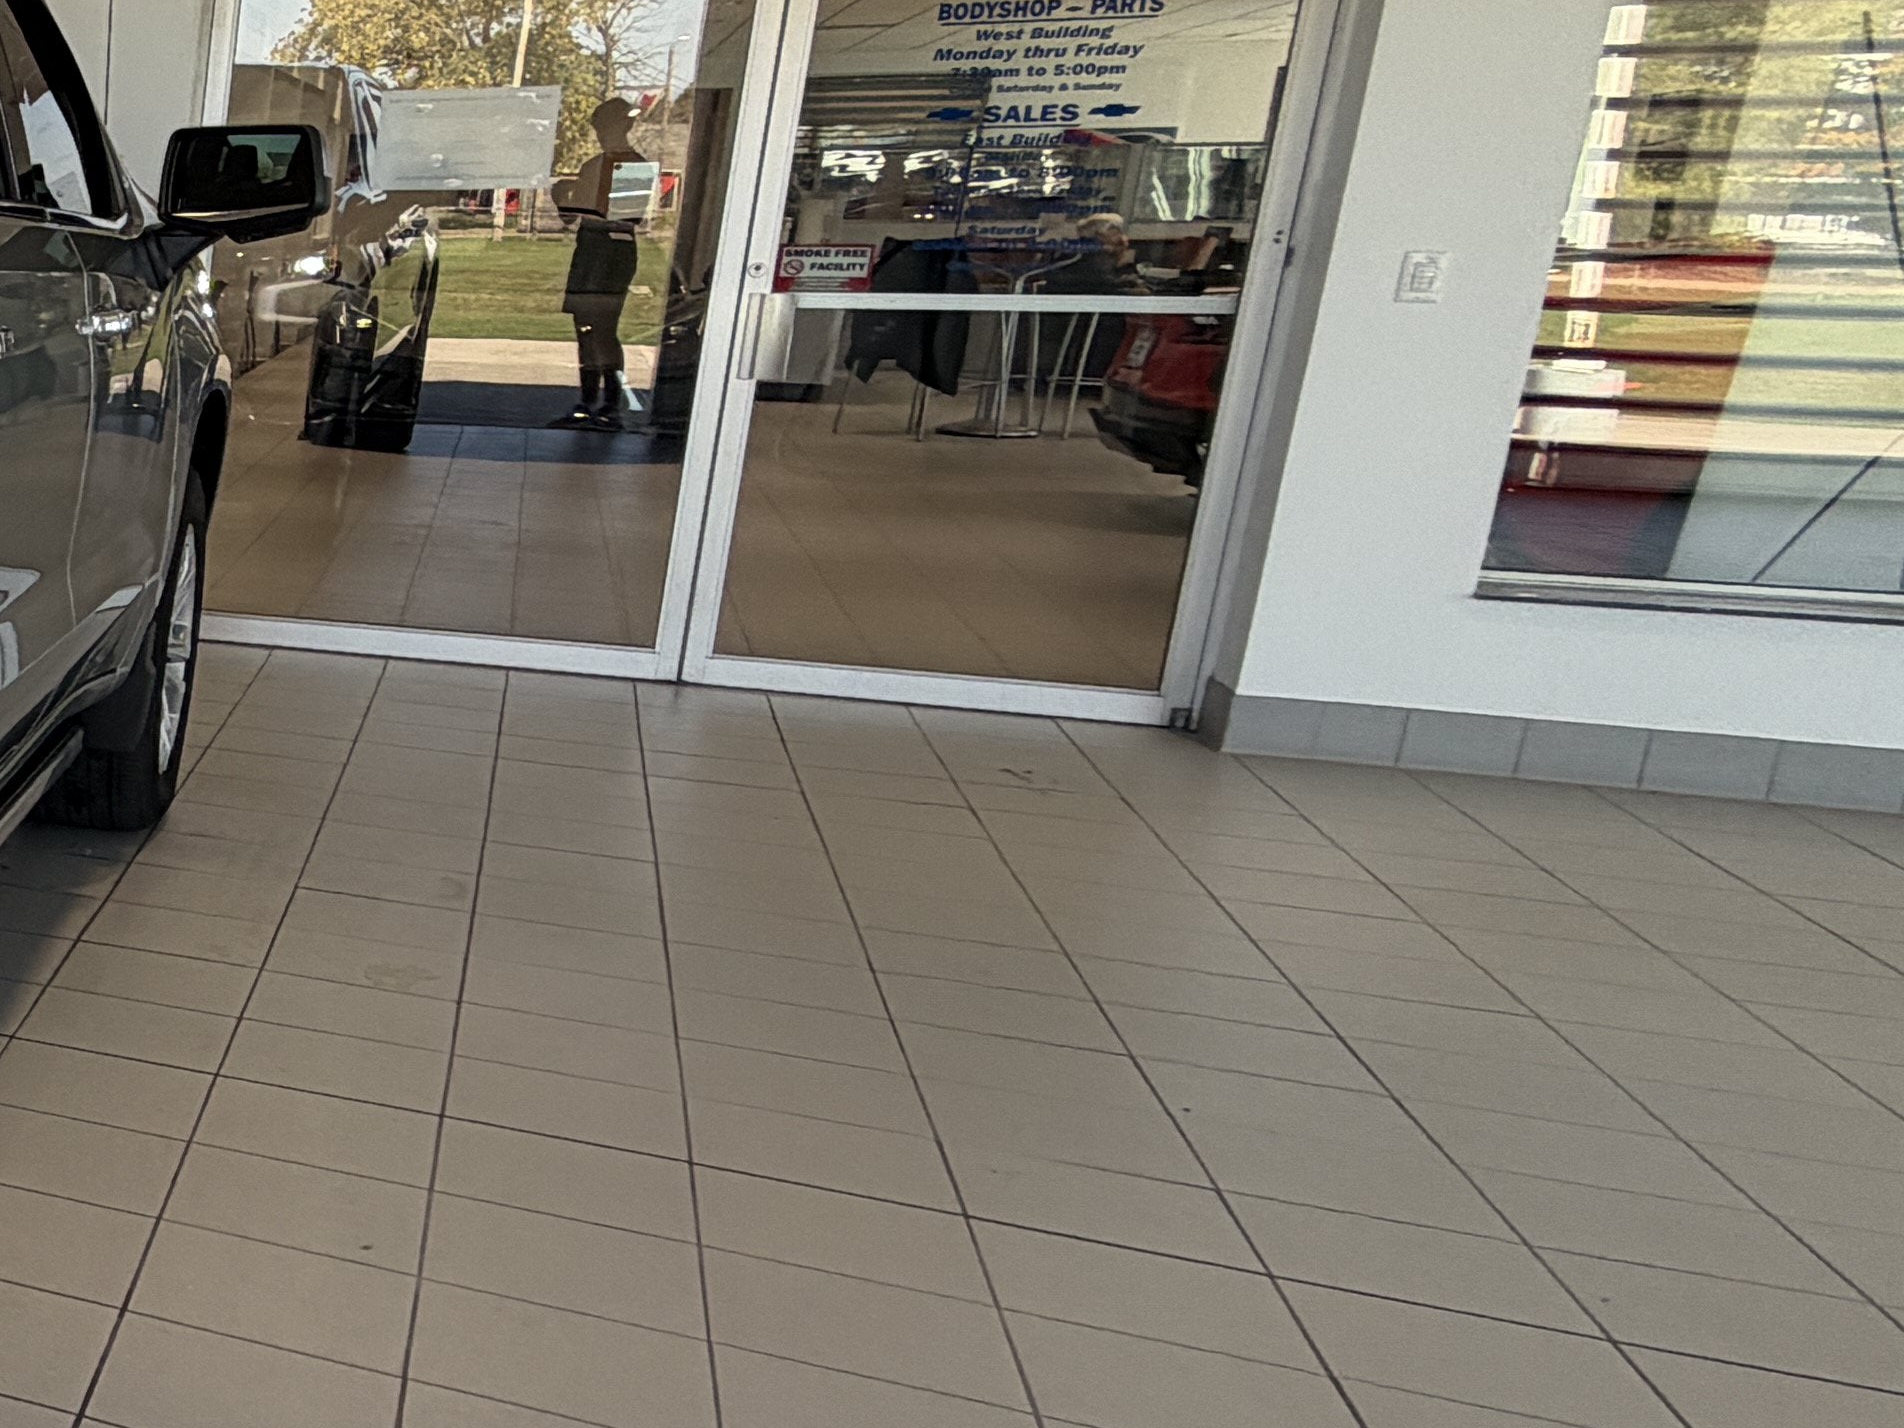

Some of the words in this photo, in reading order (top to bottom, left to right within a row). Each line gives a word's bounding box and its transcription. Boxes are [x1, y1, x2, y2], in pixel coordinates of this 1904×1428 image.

[938, 0, 1062, 21] BODYSHOP
[976, 28, 1023, 41] West
[1030, 25, 1115, 40] Building
[933, 47, 1017, 62] Monday
[1023, 45, 1068, 58] thru
[1074, 43, 1145, 59] Friday
[1027, 65, 1047, 77] to
[1053, 63, 1128, 79] 5:00pm
[996, 84, 1055, 94] Saturday
[1073, 81, 1122, 93] Sunday
[983, 103, 1080, 123] SALES
[785, 249, 831, 258] SMOKE
[834, 249, 868, 258] FREE
[810, 262, 866, 271] FACILITY
